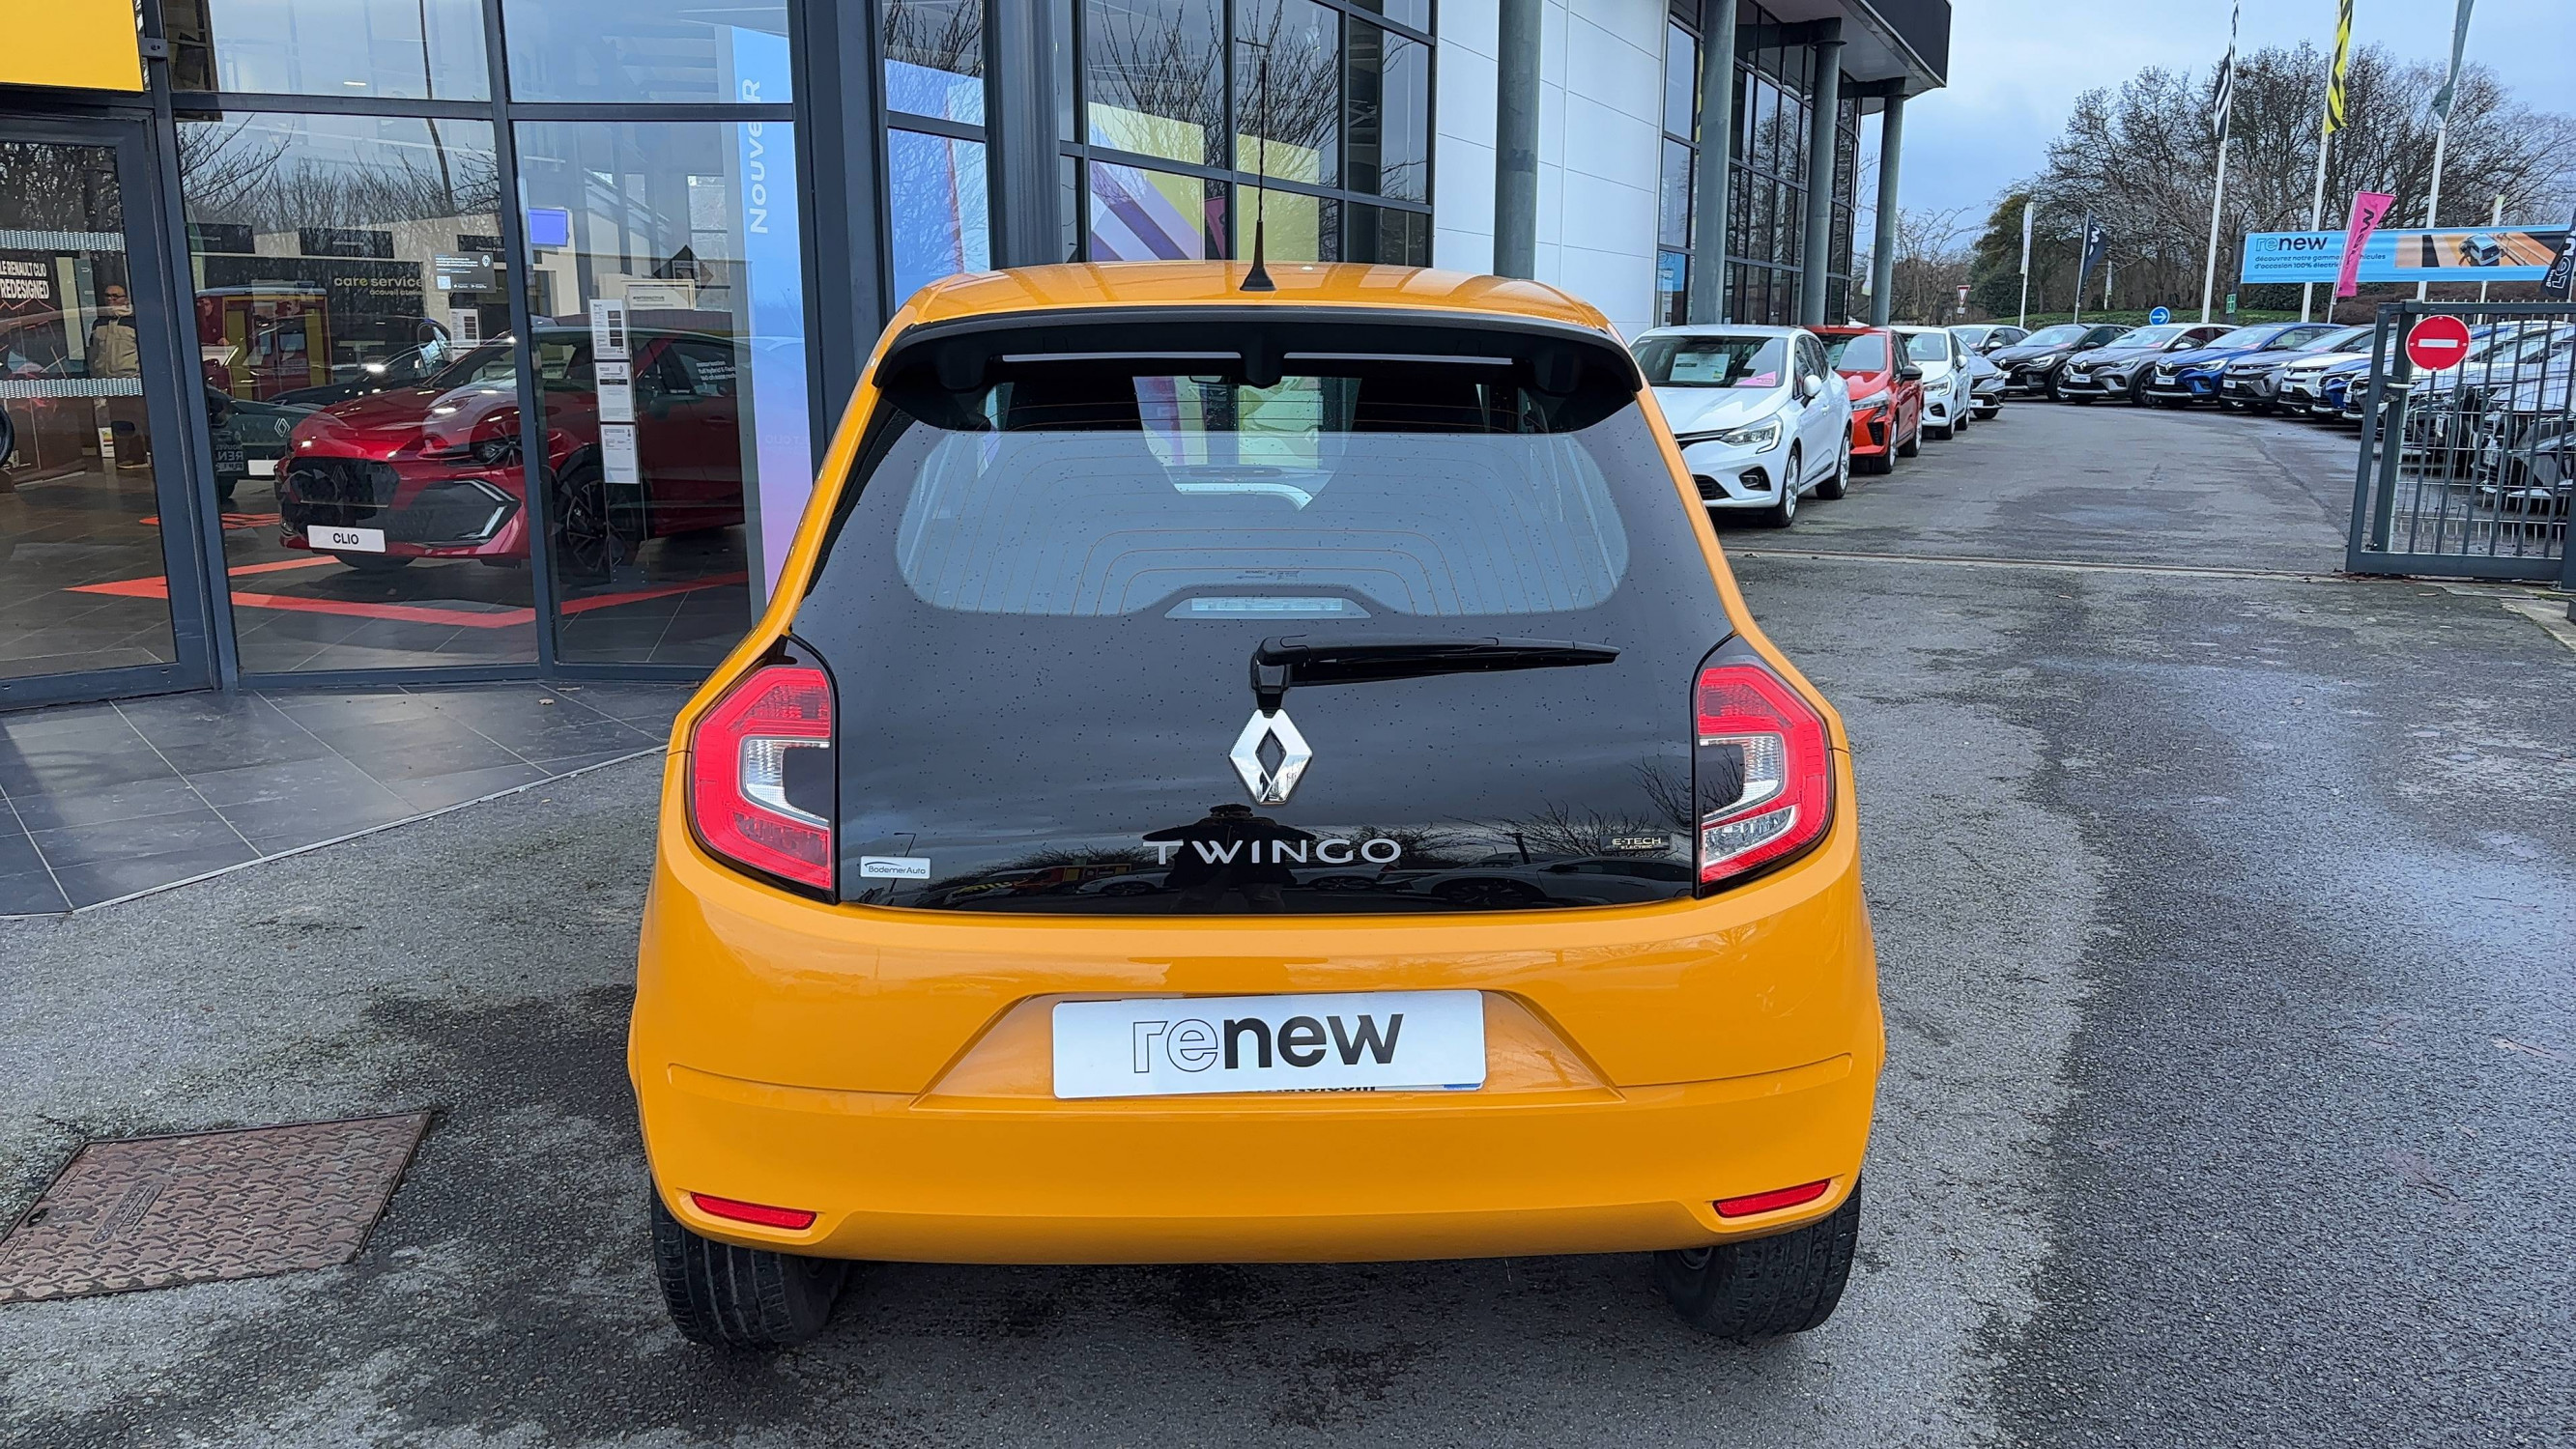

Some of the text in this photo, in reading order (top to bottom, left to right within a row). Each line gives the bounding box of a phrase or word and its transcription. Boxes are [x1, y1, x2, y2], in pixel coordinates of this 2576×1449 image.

[2255, 237, 2328, 251] renew
[333, 275, 422, 287] care service
[0, 278, 49, 299] REDESIGNED
[332, 532, 359, 545] CLIO
[1612, 837, 1662, 845] E-TECH
[1143, 838, 1402, 865] TWINGO
[1132, 1013, 1405, 1074] renew
